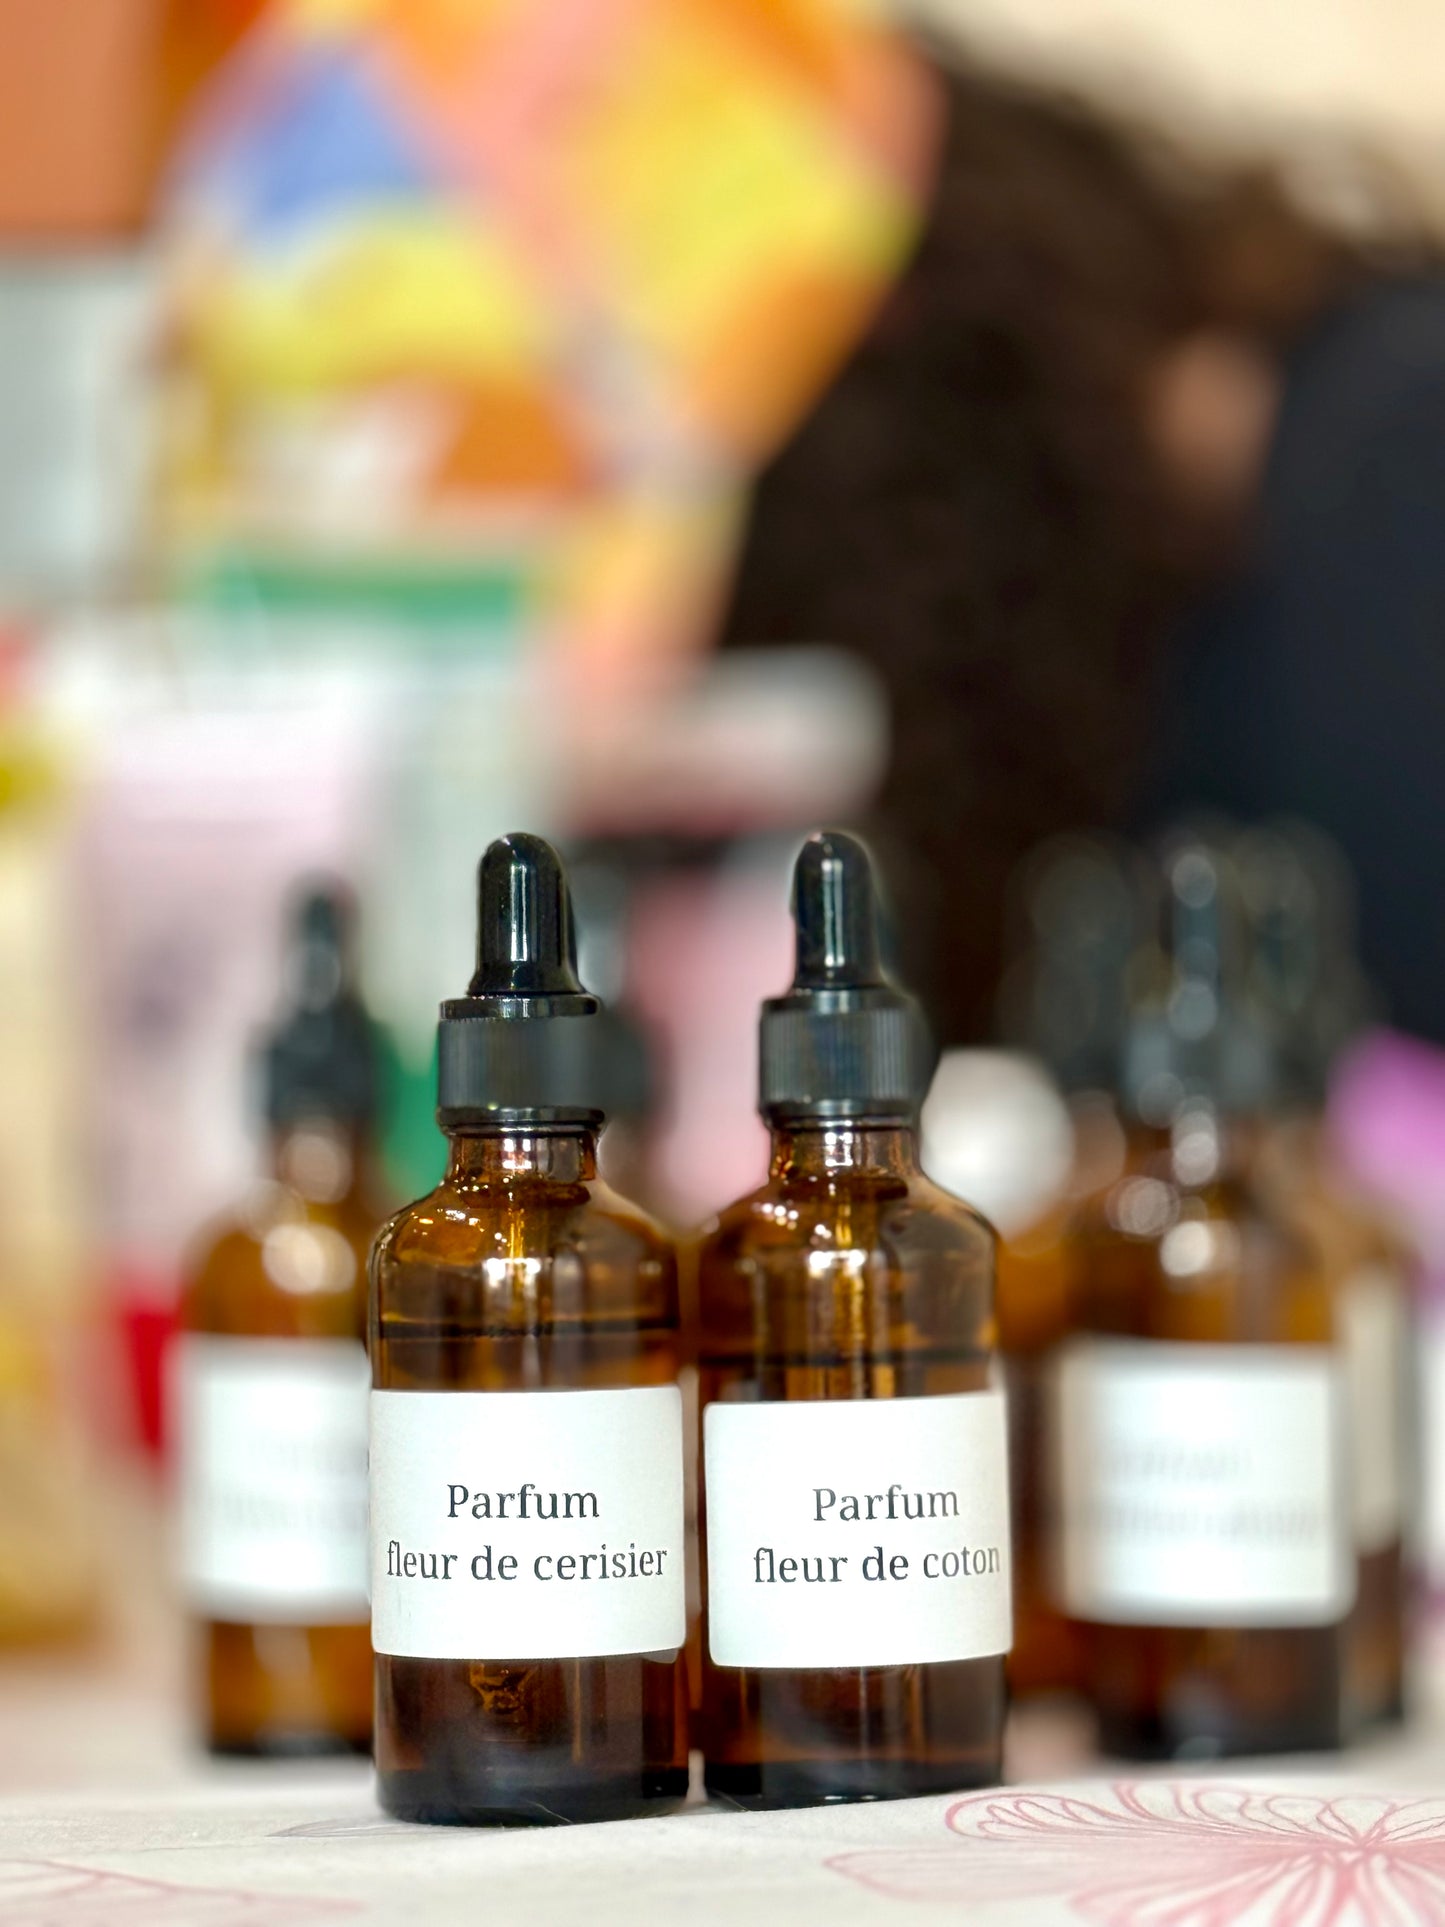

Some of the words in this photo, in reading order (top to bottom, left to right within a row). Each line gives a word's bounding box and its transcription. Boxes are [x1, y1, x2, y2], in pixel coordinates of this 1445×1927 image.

[446, 1483, 601, 1521] Parfum
[812, 1484, 960, 1522] Parfum
[386, 1539, 459, 1581] fleur
[470, 1544, 519, 1581] de
[533, 1542, 668, 1582] cerisier
[752, 1546, 849, 1584] fleur
[861, 1545, 910, 1582] de
[922, 1546, 1000, 1579] coton
